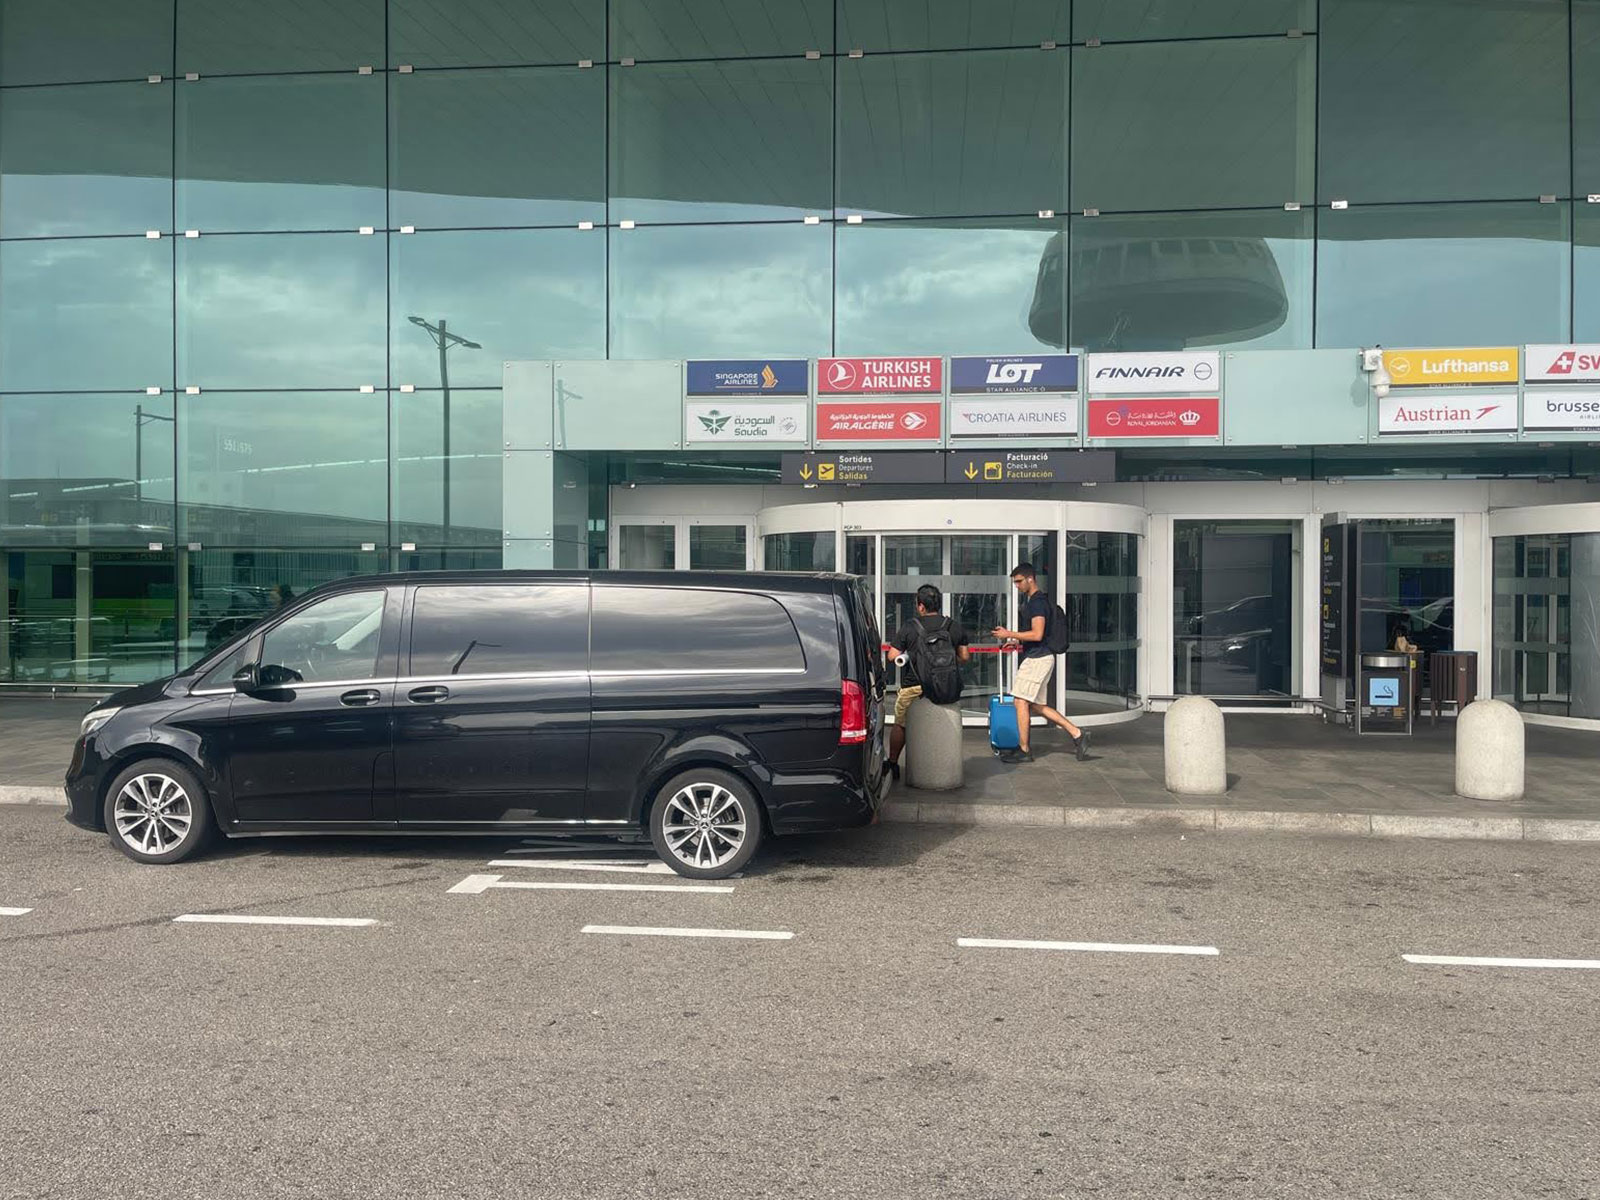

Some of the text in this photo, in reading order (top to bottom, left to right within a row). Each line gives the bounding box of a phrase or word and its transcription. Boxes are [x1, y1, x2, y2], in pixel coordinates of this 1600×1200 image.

[863, 361, 931, 374] TURKISH
[1095, 366, 1185, 378] FINNAIR
[1422, 359, 1509, 374] Lufthansa
[985, 363, 1043, 384] LOT
[861, 375, 932, 388] AIRLINES
[1547, 400, 1600, 412] brusse
[968, 412, 1067, 423] CROATIA AIRLINES
[1394, 405, 1471, 422] Austrian
[734, 416, 775, 427] السعودية
[830, 422, 849, 430] AIR
[735, 427, 767, 436] Saudia
[839, 455, 872, 463] Sortides
[1007, 453, 1048, 461] Facturació
[839, 464, 873, 472] Departures
[839, 472, 867, 480] Salidas
[1007, 470, 1053, 478] Facturación
